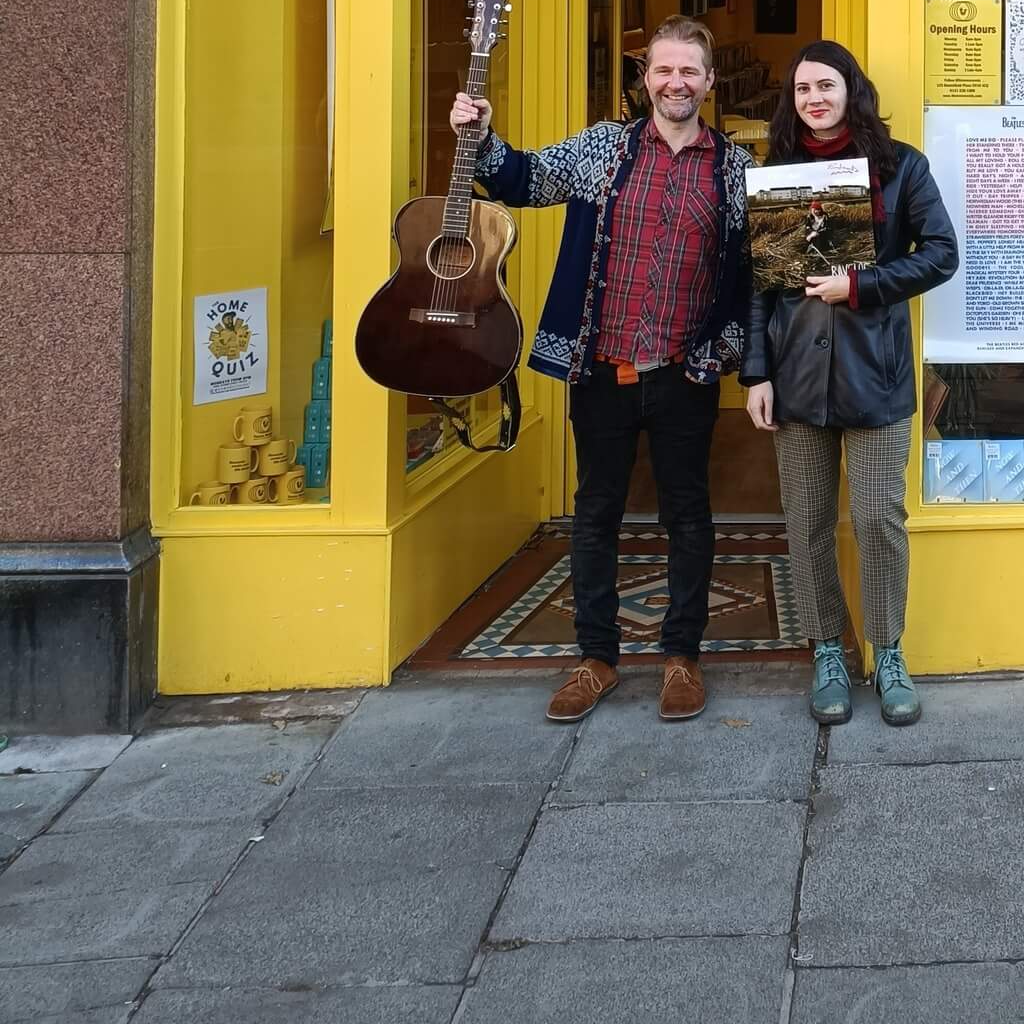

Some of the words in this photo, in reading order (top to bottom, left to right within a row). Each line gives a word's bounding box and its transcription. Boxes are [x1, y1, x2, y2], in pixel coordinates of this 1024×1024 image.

[929, 24, 968, 35] Opening
[970, 25, 997, 33] Hours
[207, 299, 248, 321] HOME
[211, 351, 259, 378] QUIZ
